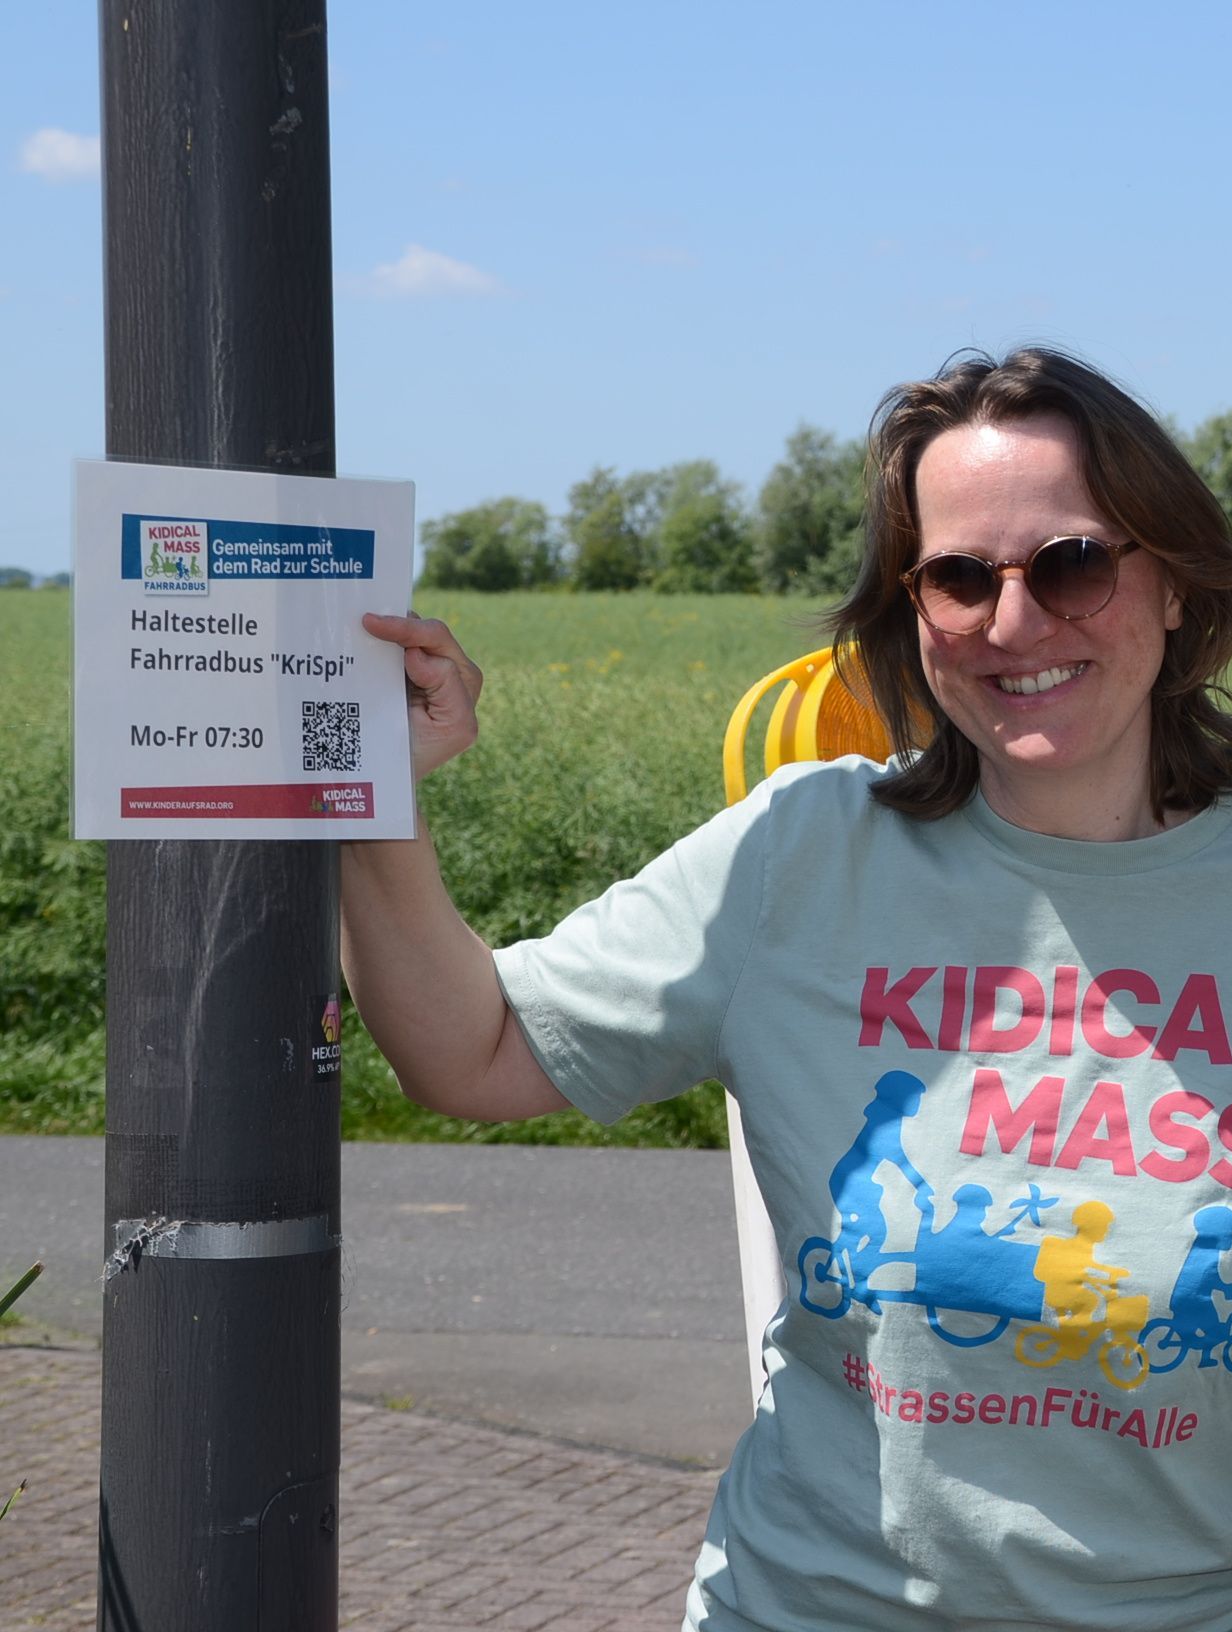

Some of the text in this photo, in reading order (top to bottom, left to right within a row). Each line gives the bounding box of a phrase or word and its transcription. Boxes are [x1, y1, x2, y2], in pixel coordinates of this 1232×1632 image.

[148, 526, 200, 539] KIDICAL
[163, 540, 200, 553] MASS
[212, 539, 333, 555] Gemeinsam mit
[213, 557, 363, 575] dem Rad zur Schule
[144, 580, 206, 591] FAHRRADBUS
[131, 610, 258, 636] Haltestelle
[130, 648, 355, 682] Fahrradbus "KriSpi"
[130, 725, 264, 749] Mo-Fr 07:30
[322, 788, 366, 802] KIDICAL
[129, 801, 234, 810] WWW.KINDERAUFSRAD.ORG
[335, 801, 366, 812] MASS
[312, 1044, 341, 1060] HEX.CO
[842, 1352, 1198, 1448] #StrassenFürAlle
